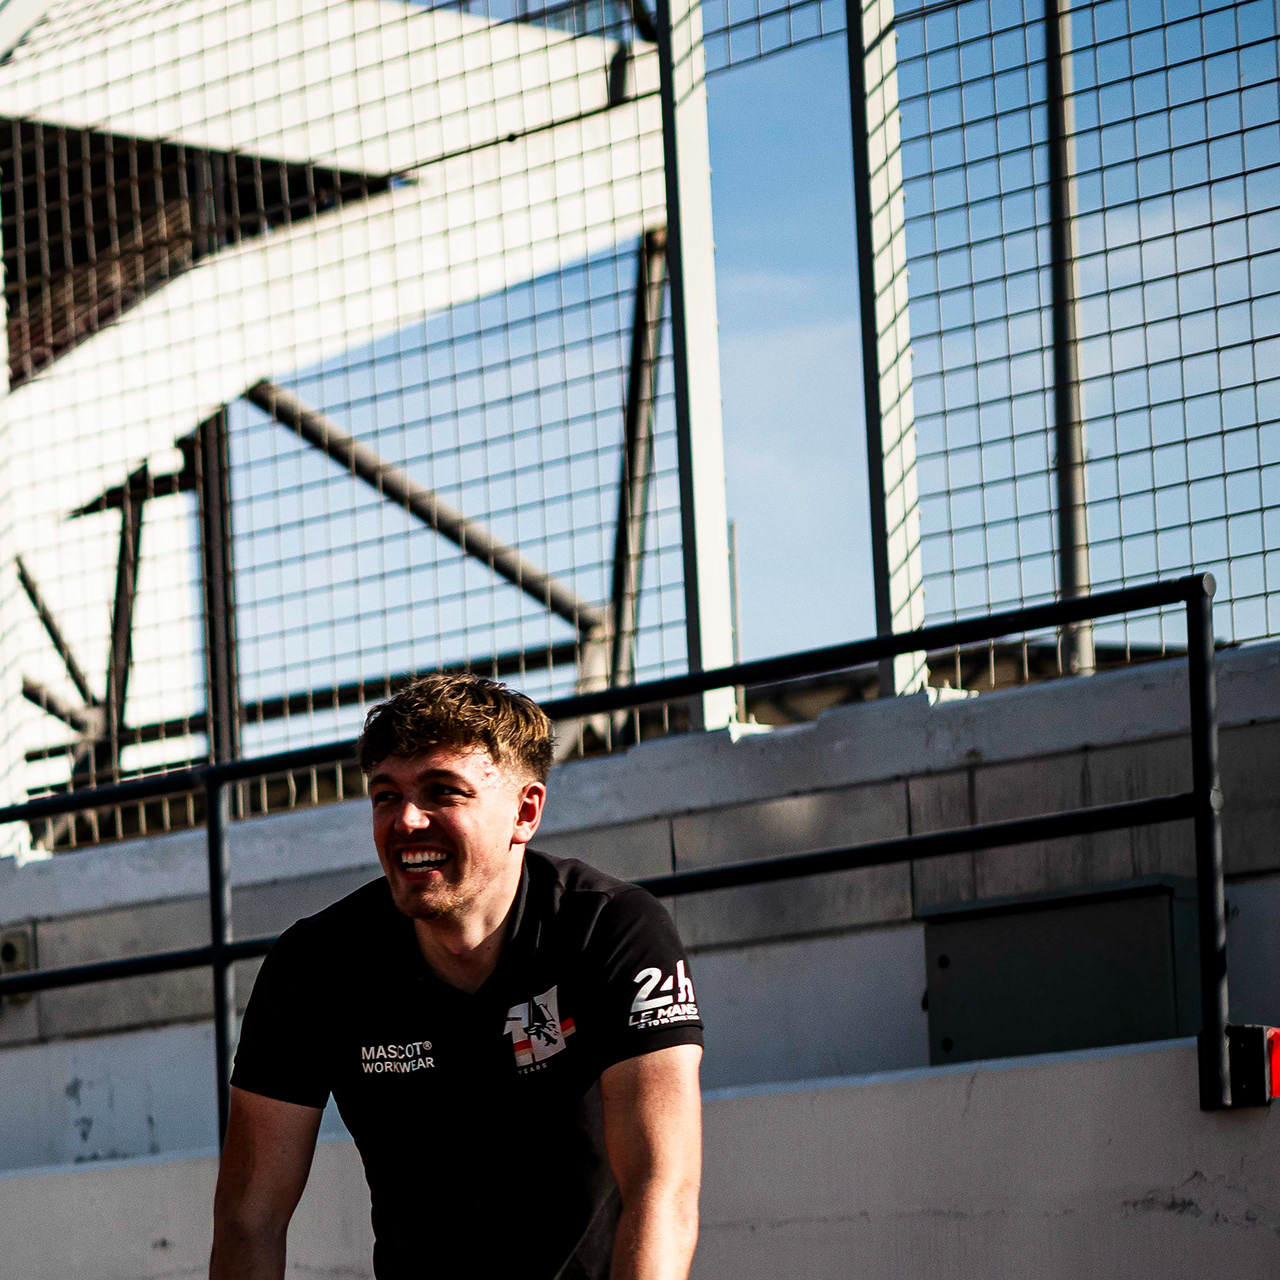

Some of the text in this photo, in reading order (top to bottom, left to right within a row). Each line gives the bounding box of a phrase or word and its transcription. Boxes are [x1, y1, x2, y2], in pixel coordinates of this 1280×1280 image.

[630, 959, 695, 1013] 24h
[628, 1011, 654, 1026] LE
[657, 1003, 698, 1019] MANS
[362, 1057, 435, 1073] WORKWEAR
